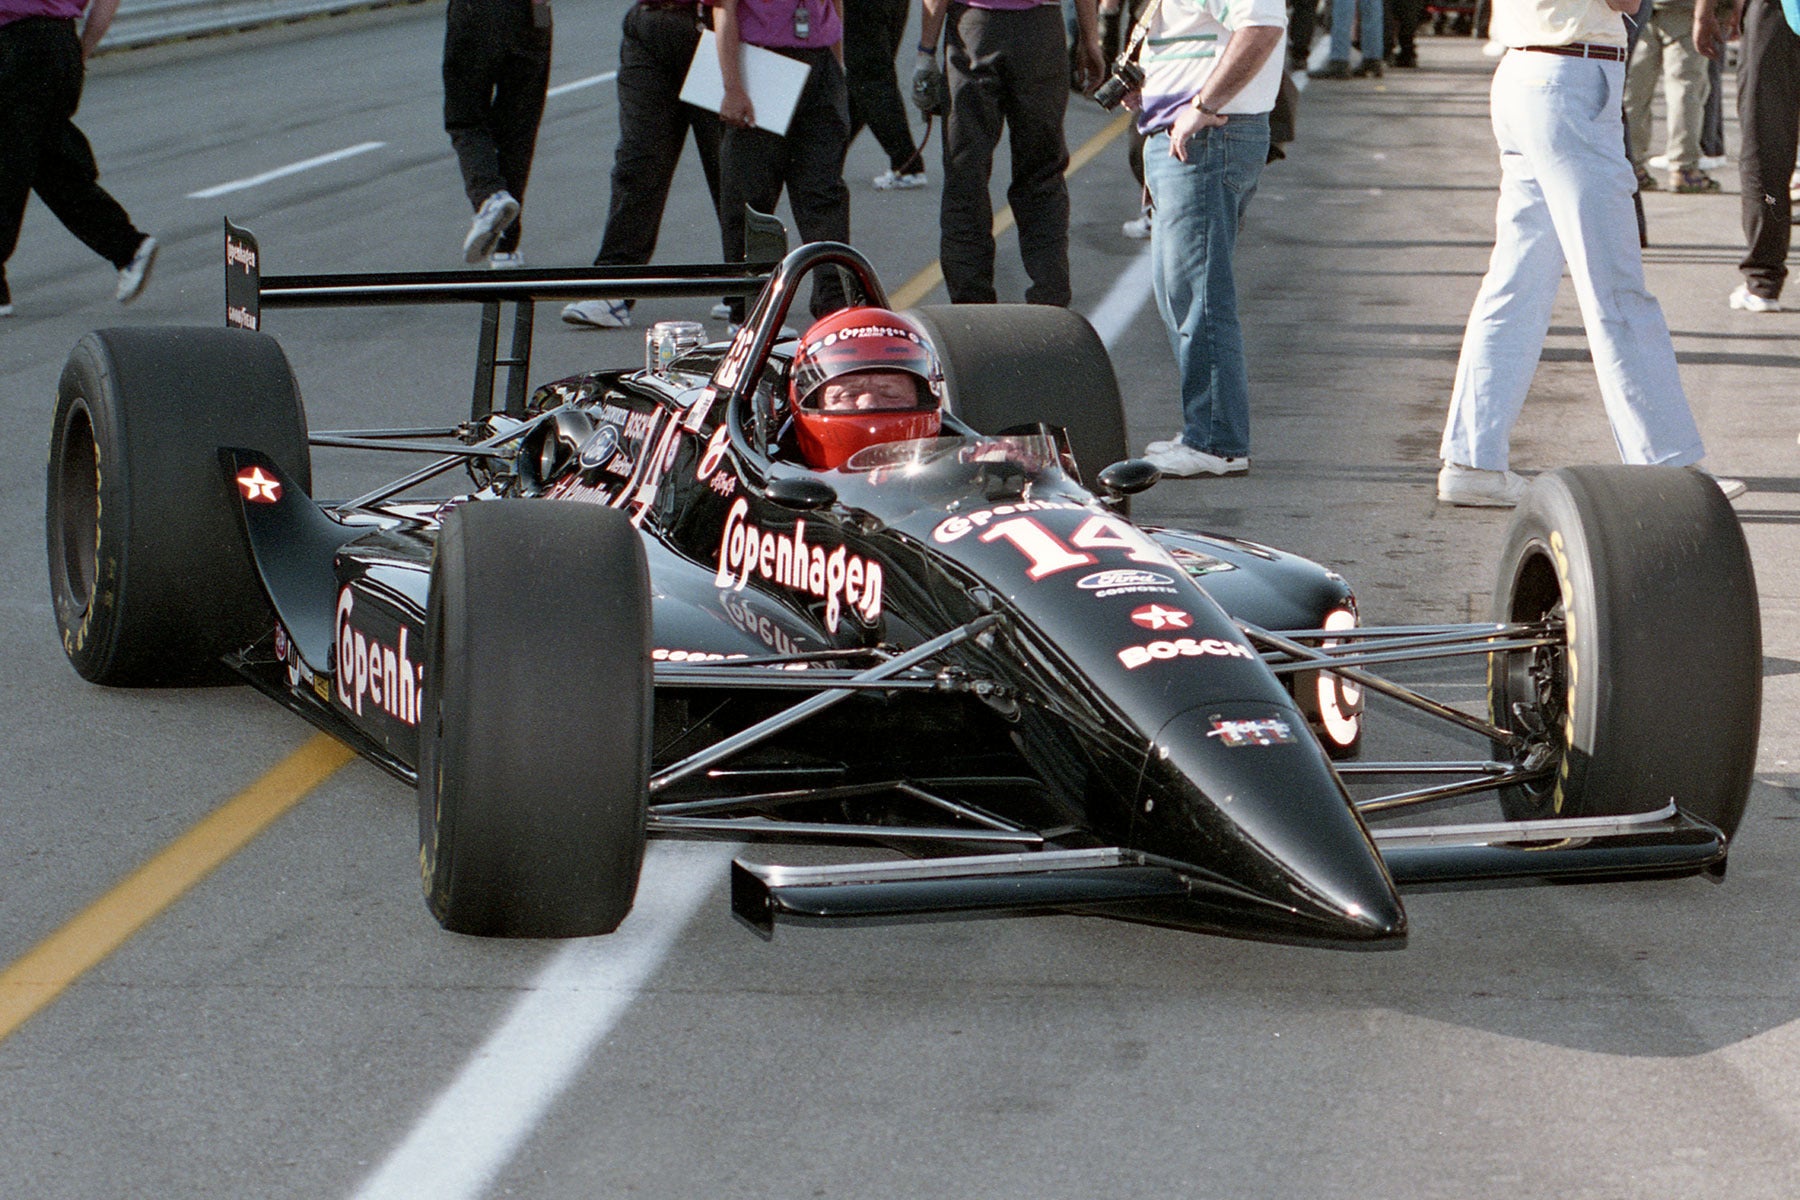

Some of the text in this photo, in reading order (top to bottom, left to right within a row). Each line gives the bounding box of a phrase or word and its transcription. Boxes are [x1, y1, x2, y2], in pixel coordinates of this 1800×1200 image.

[838, 325, 906, 341] Copenhagen
[714, 497, 882, 633] Copenhagen
[978, 515, 1180, 582] 14
[1094, 585, 1180, 598] COSWORTH
[336, 585, 423, 727] Copenh
[1118, 638, 1255, 670] BOSCH
